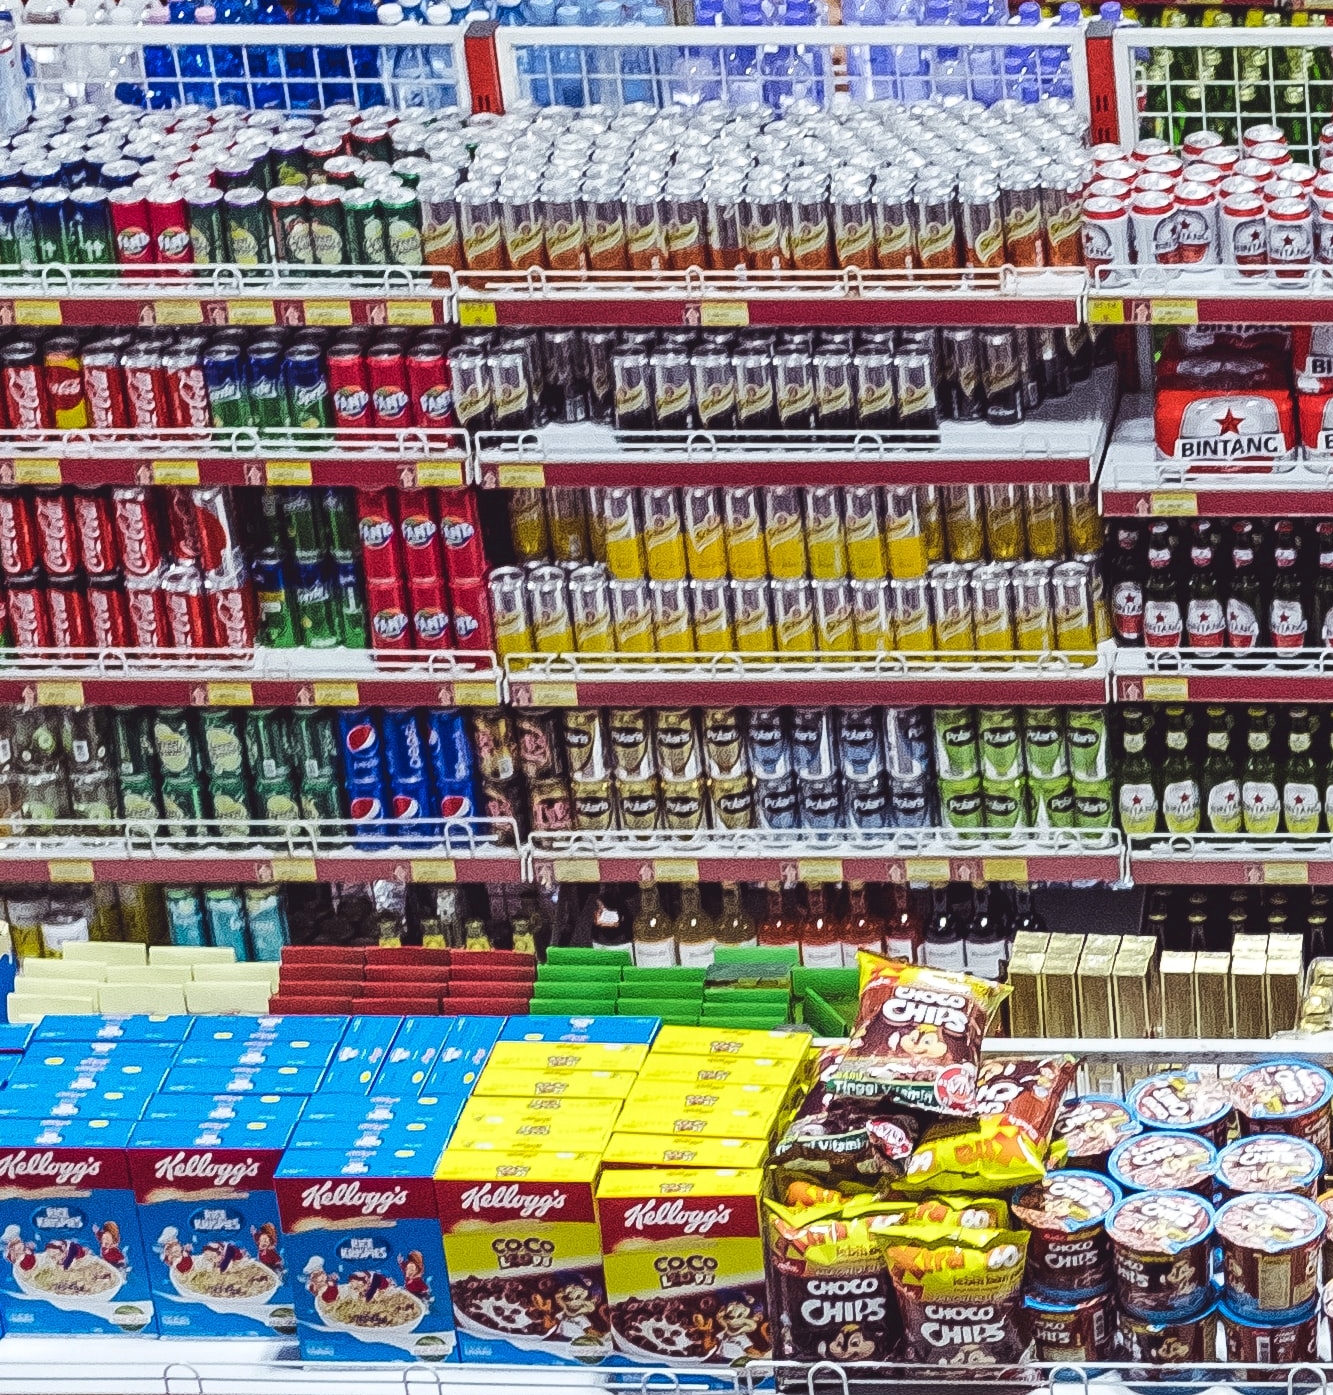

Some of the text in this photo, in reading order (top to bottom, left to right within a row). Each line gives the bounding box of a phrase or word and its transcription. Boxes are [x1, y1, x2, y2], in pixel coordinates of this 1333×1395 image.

[1181, 438, 1279, 459] BINTANG
[895, 986, 967, 1011] CHOCO
[882, 1000, 969, 1033] CHIPS
[155, 1152, 261, 1183] Kellogg's
[302, 1181, 407, 1213] Kellogg's
[461, 1183, 567, 1216] Kellogg's
[625, 1200, 733, 1232] Kellogg's
[807, 1278, 878, 1295] CHOCO
[801, 1300, 887, 1326] CHIPS
[925, 1304, 995, 1322] CHOCO
[920, 1322, 1006, 1347] CHIPS
